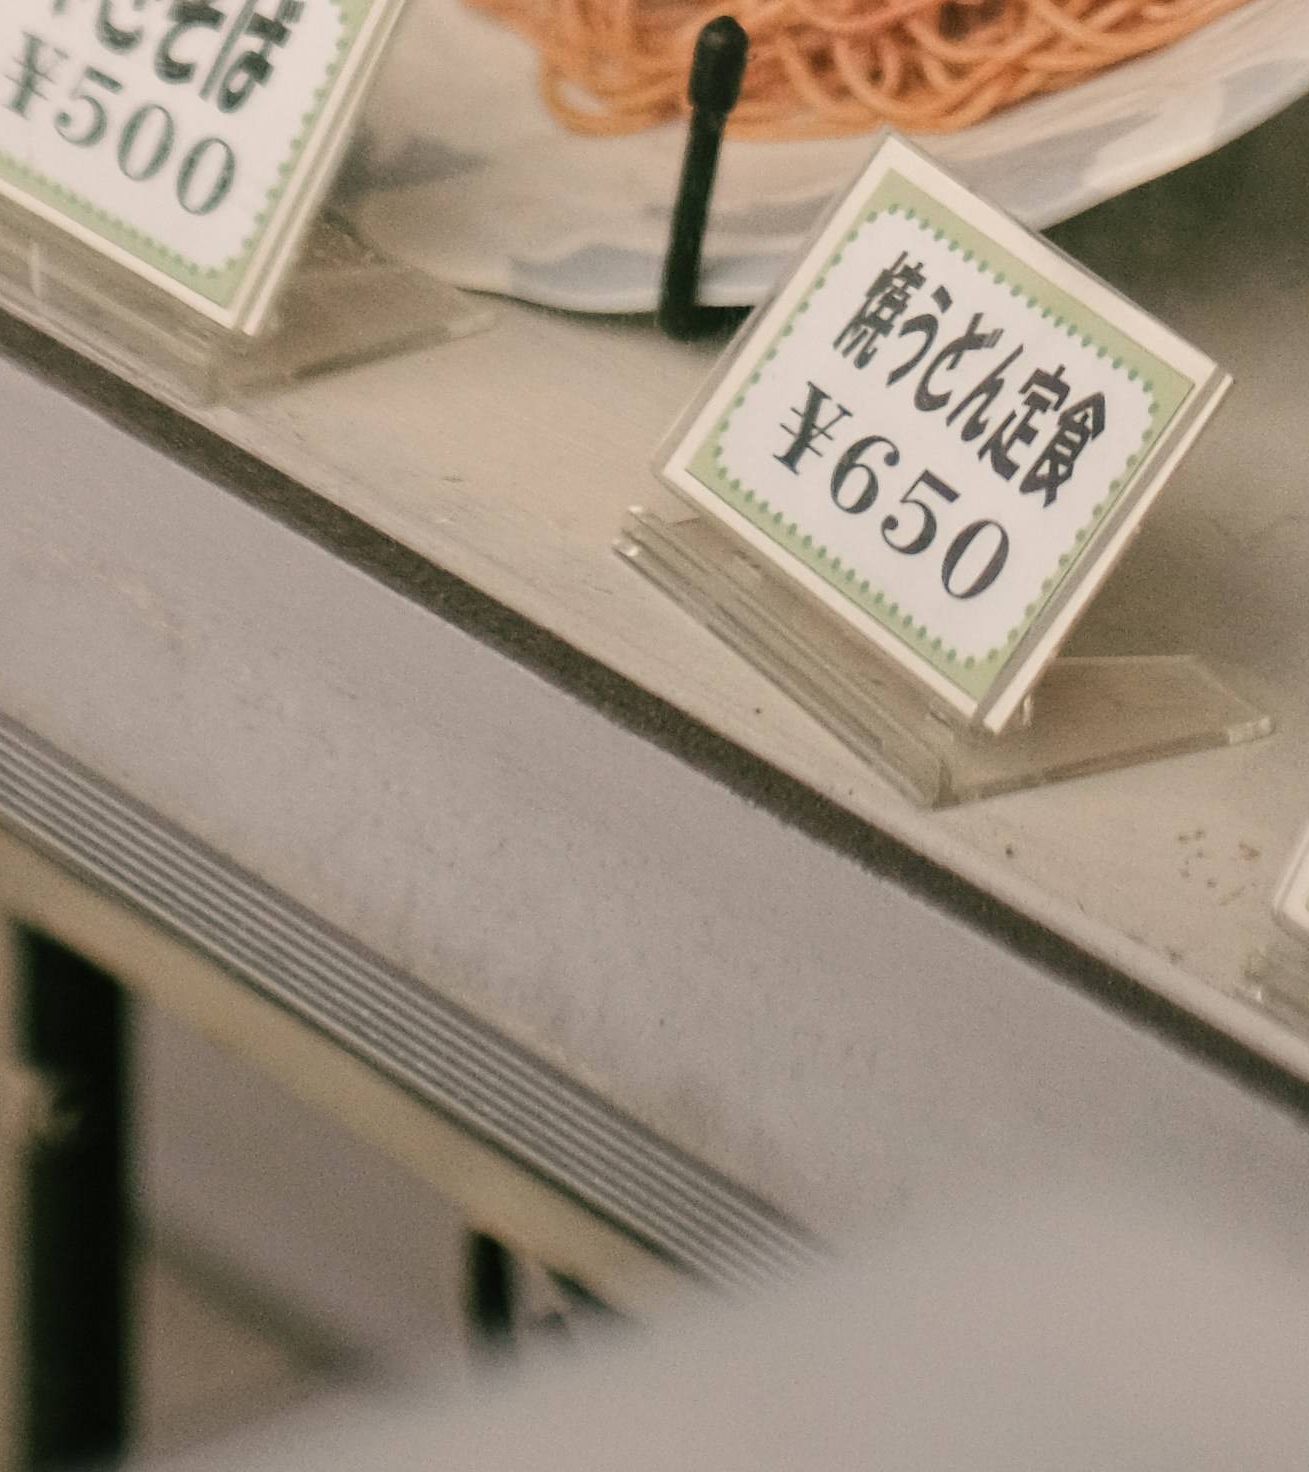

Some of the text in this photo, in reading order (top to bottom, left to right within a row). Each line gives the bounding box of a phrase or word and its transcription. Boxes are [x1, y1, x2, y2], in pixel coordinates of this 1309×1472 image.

[2, 30, 236, 217] ¥500
[832, 250, 1108, 509] 焼うどん定食
[772, 380, 1011, 602] ¥650
